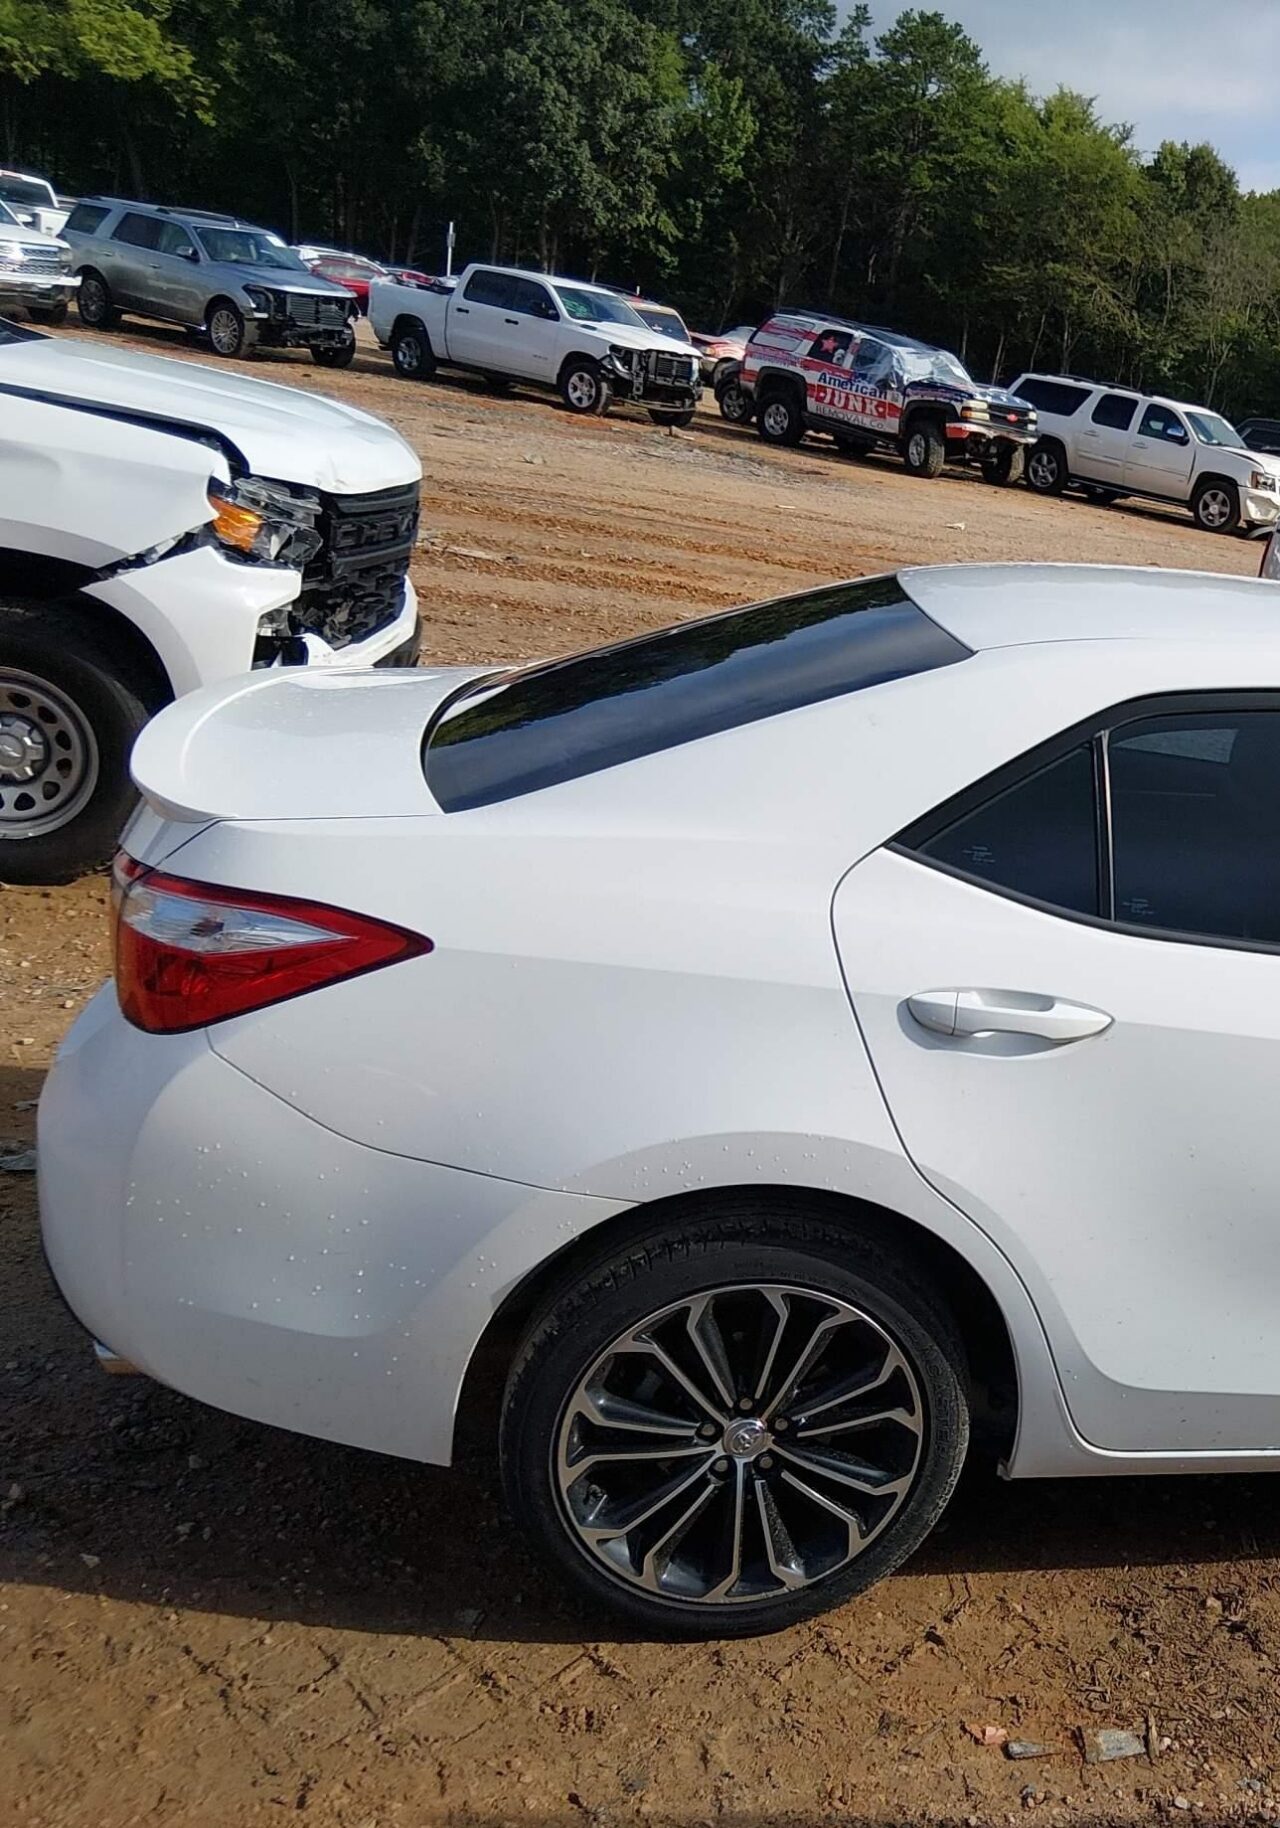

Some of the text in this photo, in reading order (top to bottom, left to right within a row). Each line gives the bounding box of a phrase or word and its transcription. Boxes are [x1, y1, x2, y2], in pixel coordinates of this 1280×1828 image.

[818, 371, 888, 401] American
[815, 405, 867, 426] REMOVAL
[822, 388, 879, 417] JUNK
